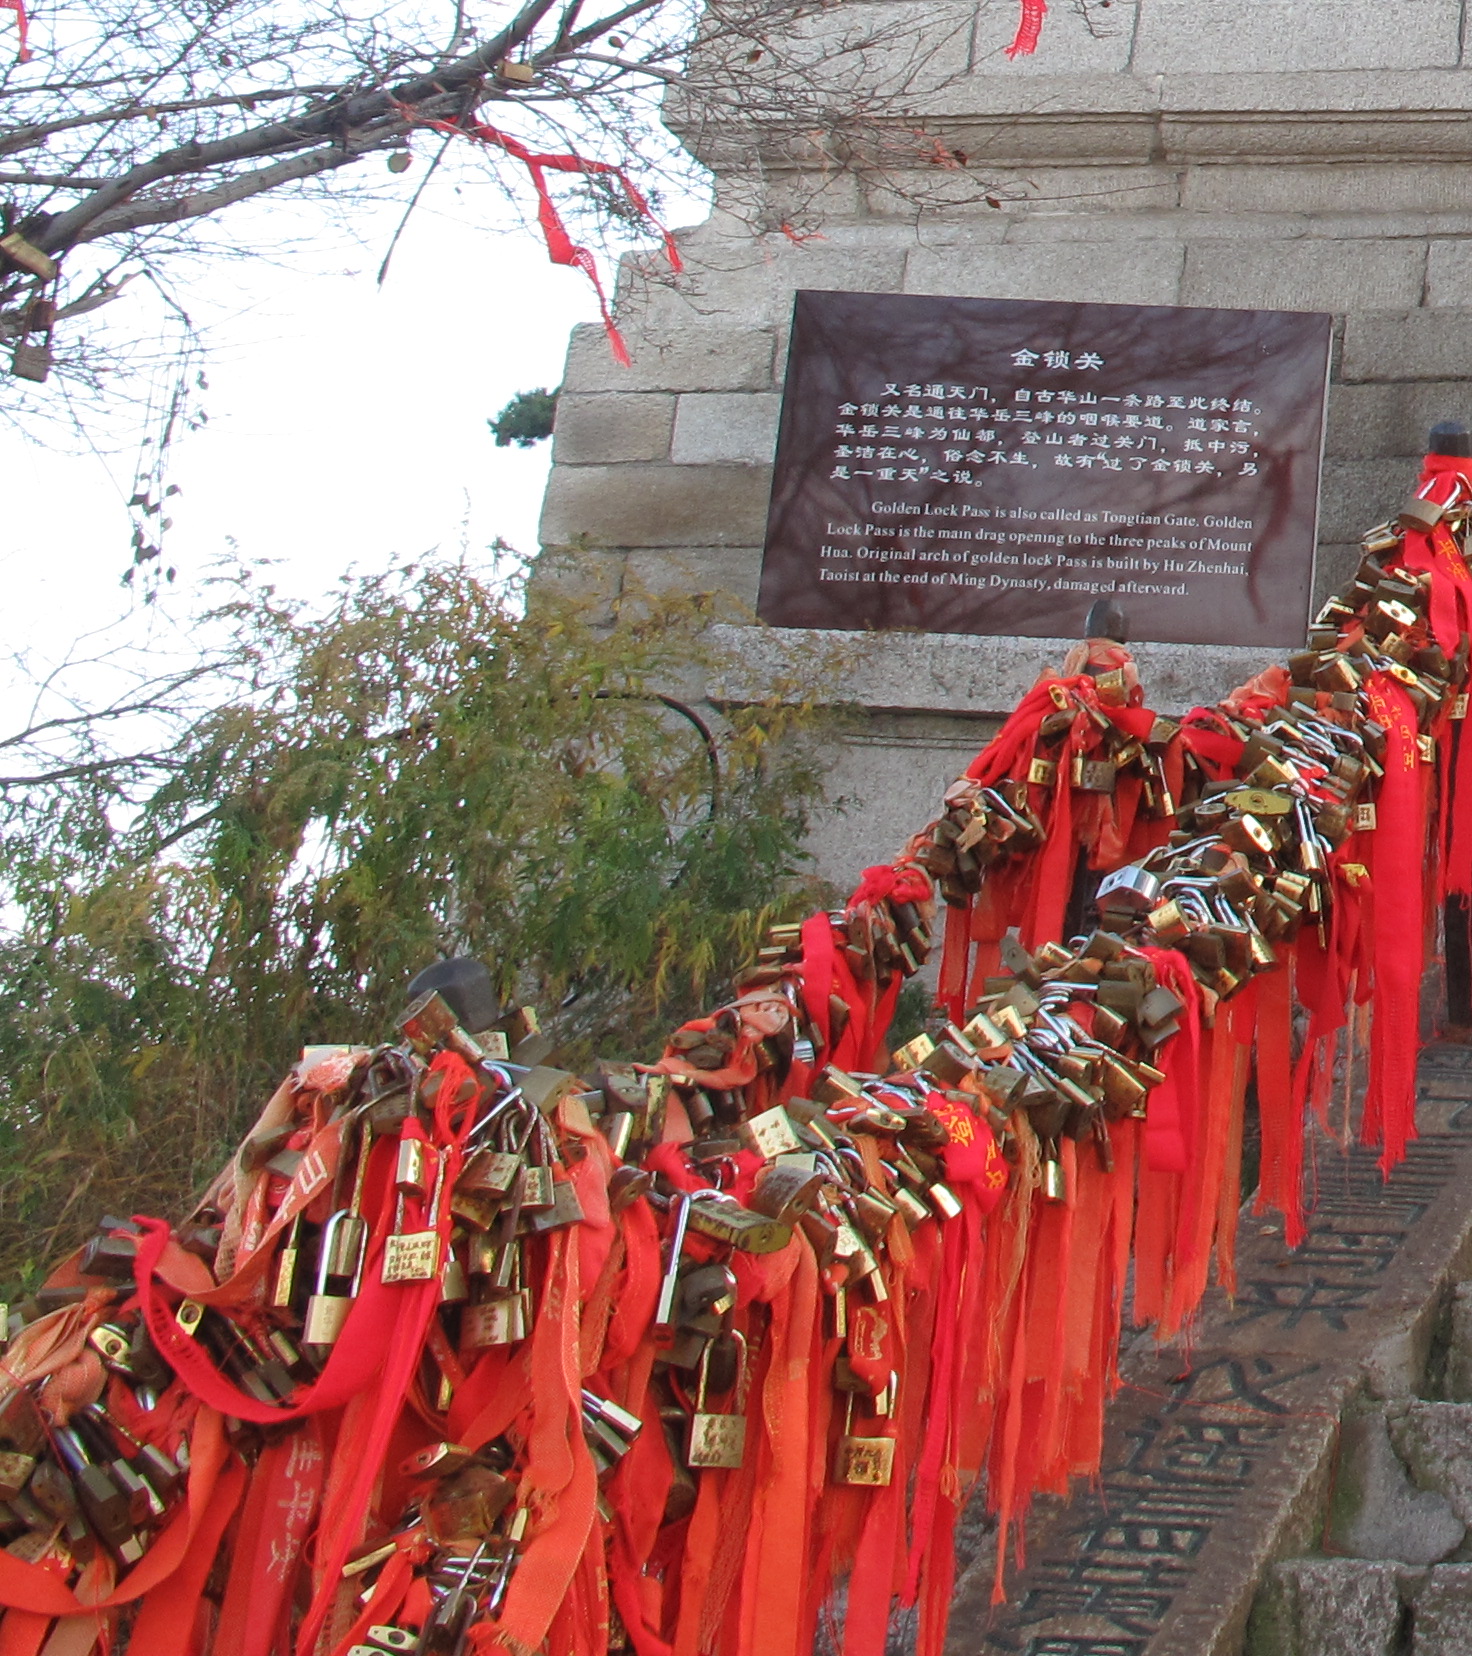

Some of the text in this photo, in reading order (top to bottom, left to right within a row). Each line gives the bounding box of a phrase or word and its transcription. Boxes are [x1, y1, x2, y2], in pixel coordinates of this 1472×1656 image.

[1010, 347, 1104, 371] 金锁关
[872, 501, 1253, 529] Golden Lock Pass is also called as Tongtian Gate. Golden
[827, 523, 1252, 552] Lock Pass is the main drag opening to the three peaks of Mount
[820, 546, 1249, 576] Hua. Original arch of golden lock Pass is built by Hu Zhenhai,
[820, 569, 1189, 596] Taoist at the end of Ming Dynasty, damaged afterward.
